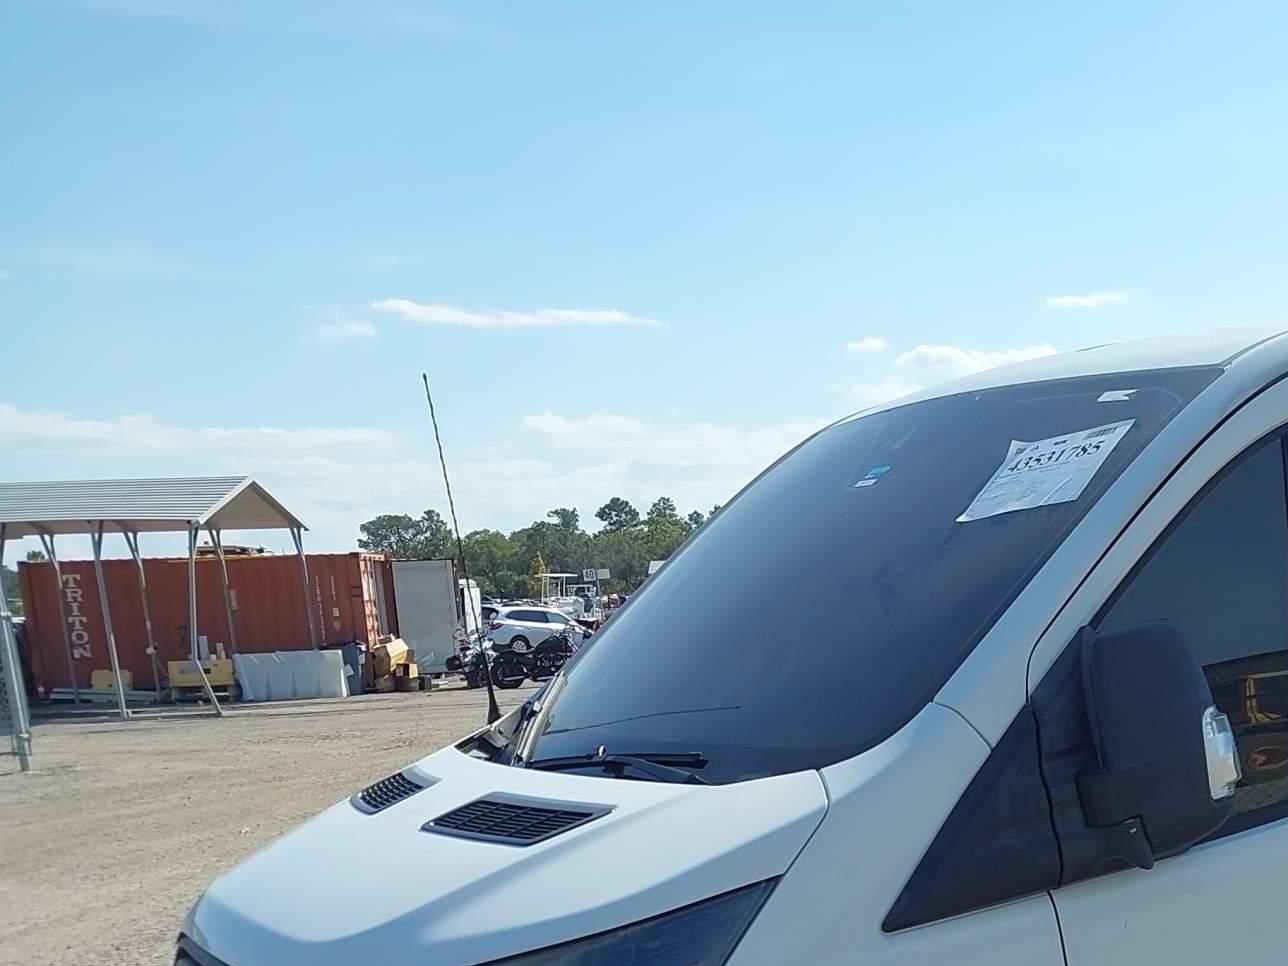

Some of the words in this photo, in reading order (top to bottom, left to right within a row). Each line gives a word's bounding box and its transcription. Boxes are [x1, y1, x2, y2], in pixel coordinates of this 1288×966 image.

[1008, 440, 1106, 472] 43531785
[584, 569, 594, 580] 40
[62, 574, 92, 658] TRITON
